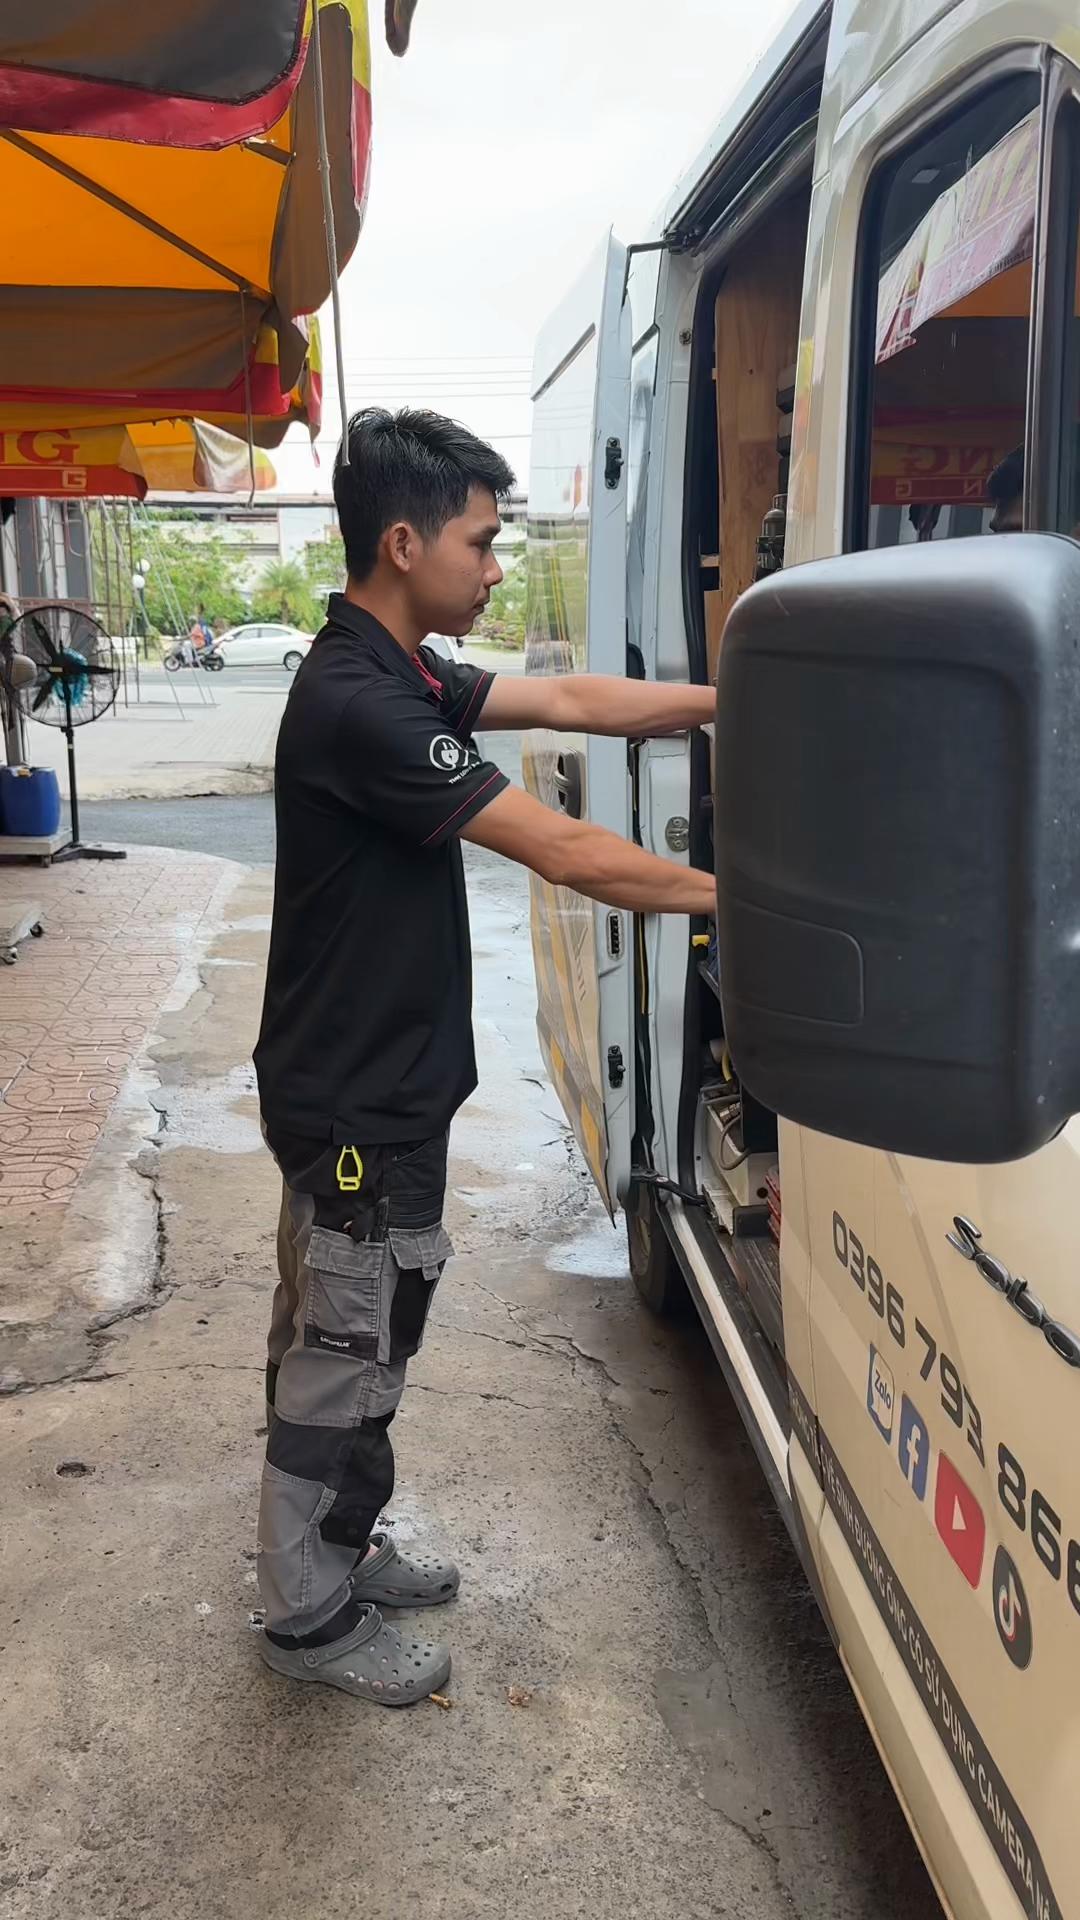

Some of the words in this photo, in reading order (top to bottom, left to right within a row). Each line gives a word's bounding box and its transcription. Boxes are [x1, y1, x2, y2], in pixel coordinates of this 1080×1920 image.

[0, 430, 80, 465] G
[62, 470, 87, 488] G
[833, 1210, 905, 1348] 0396
[915, 1317, 985, 1468] 793
[874, 1369, 891, 1409] Zalo
[854, 1514, 885, 1598] ĐƯỜNG
[886, 1575, 907, 1642] ỐNG
[908, 1626, 924, 1674] CÓ
[925, 1657, 939, 1706] SỬ
[941, 1688, 976, 1780] DỤNG
[977, 1764, 1035, 1905] CAMERA
